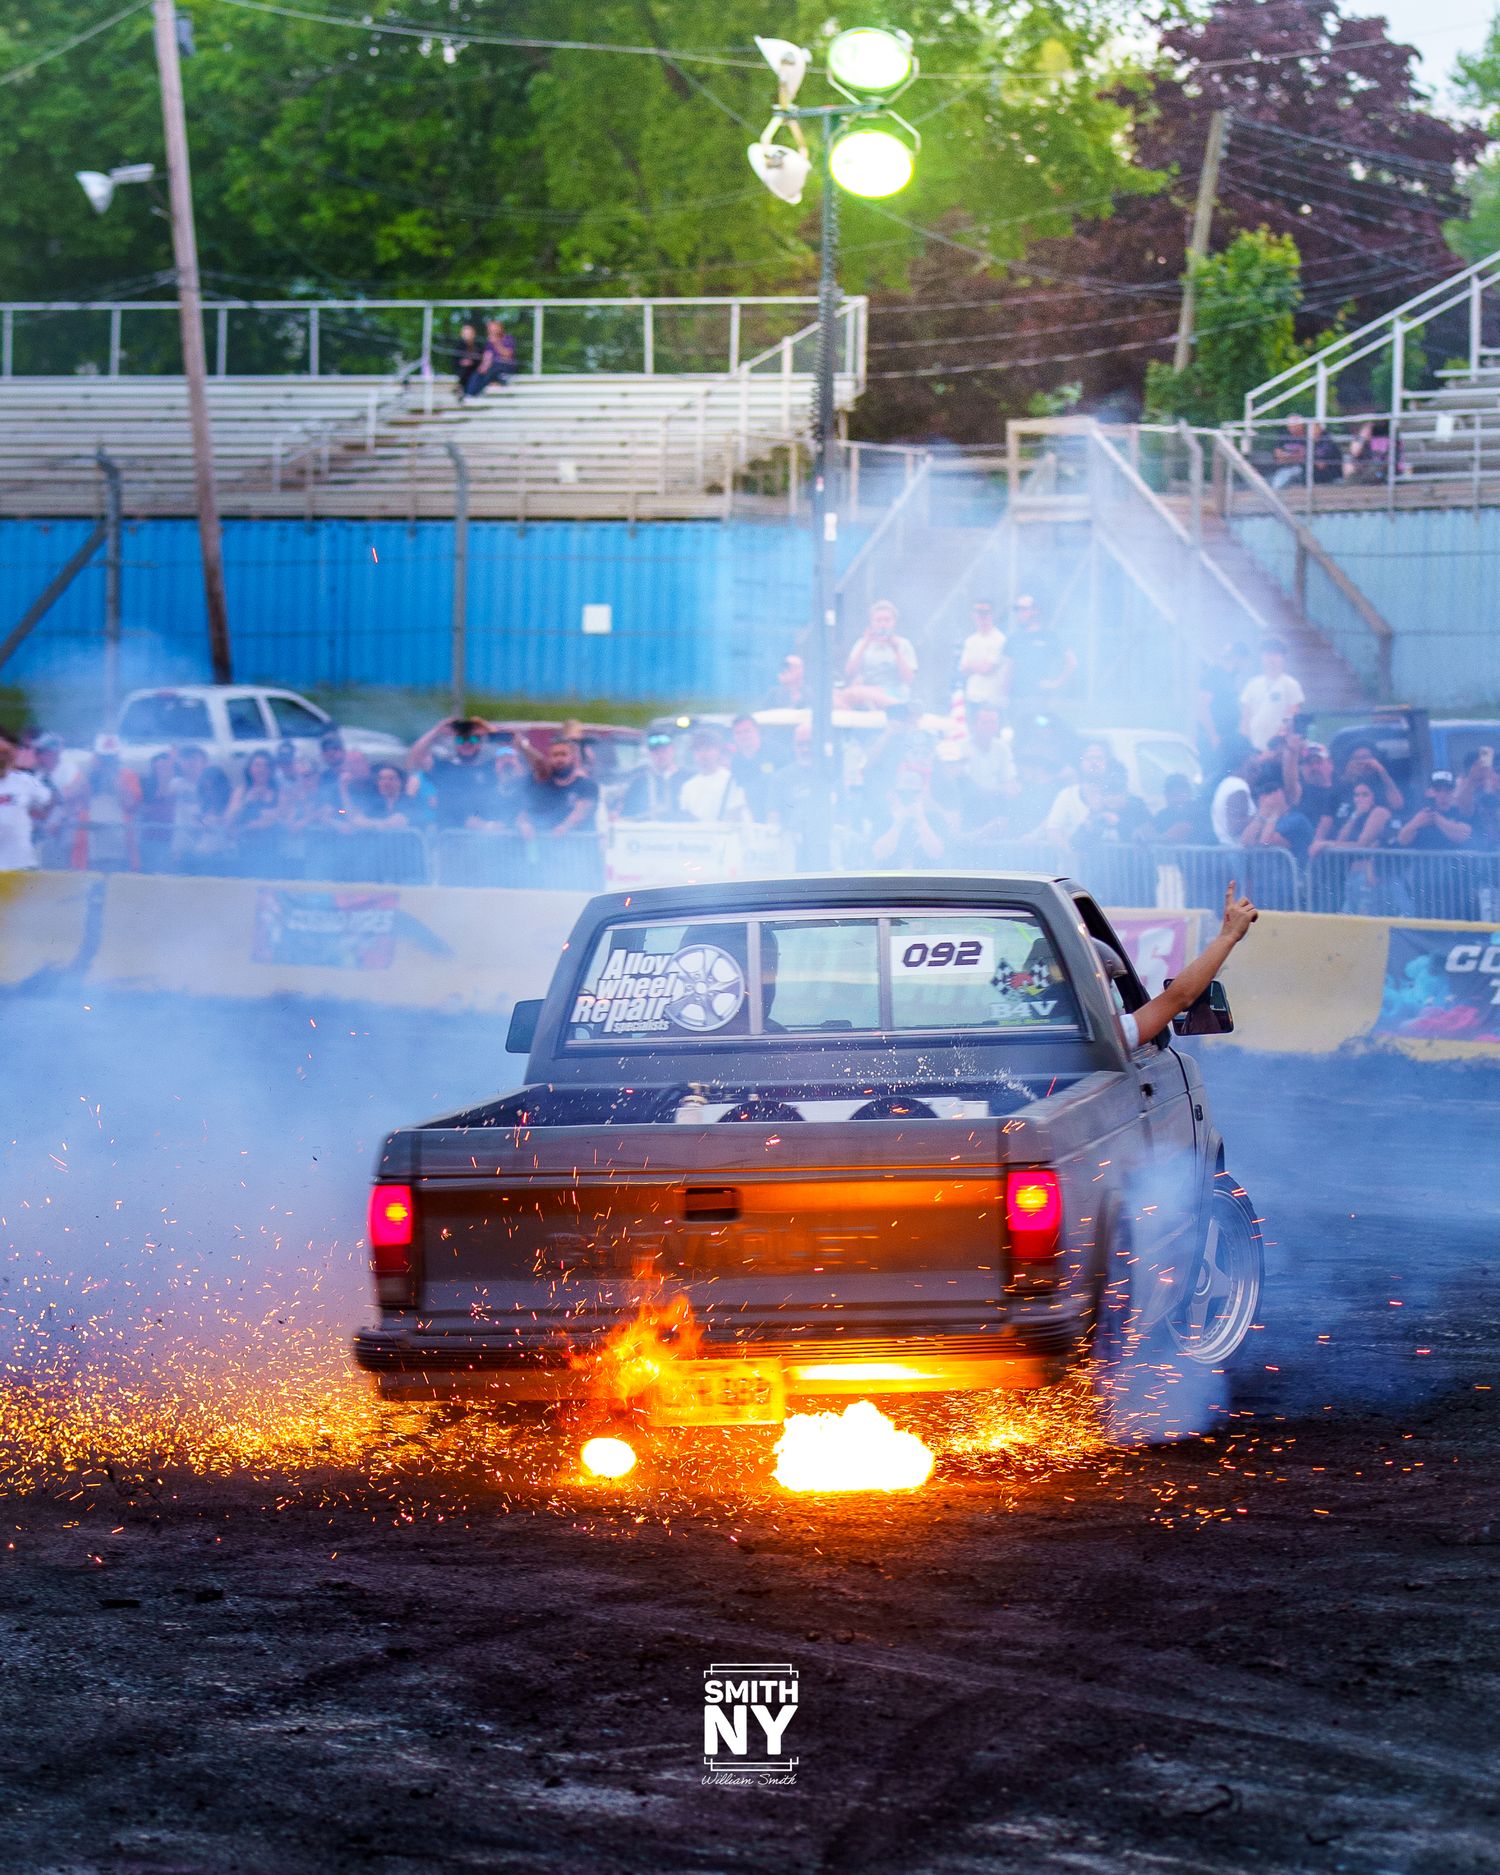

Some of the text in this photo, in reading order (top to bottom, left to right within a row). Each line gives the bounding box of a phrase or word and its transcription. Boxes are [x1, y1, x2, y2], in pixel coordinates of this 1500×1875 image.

[602, 949, 674, 979] Alloy
[903, 941, 982, 968] 092
[570, 995, 671, 1033] Repair
